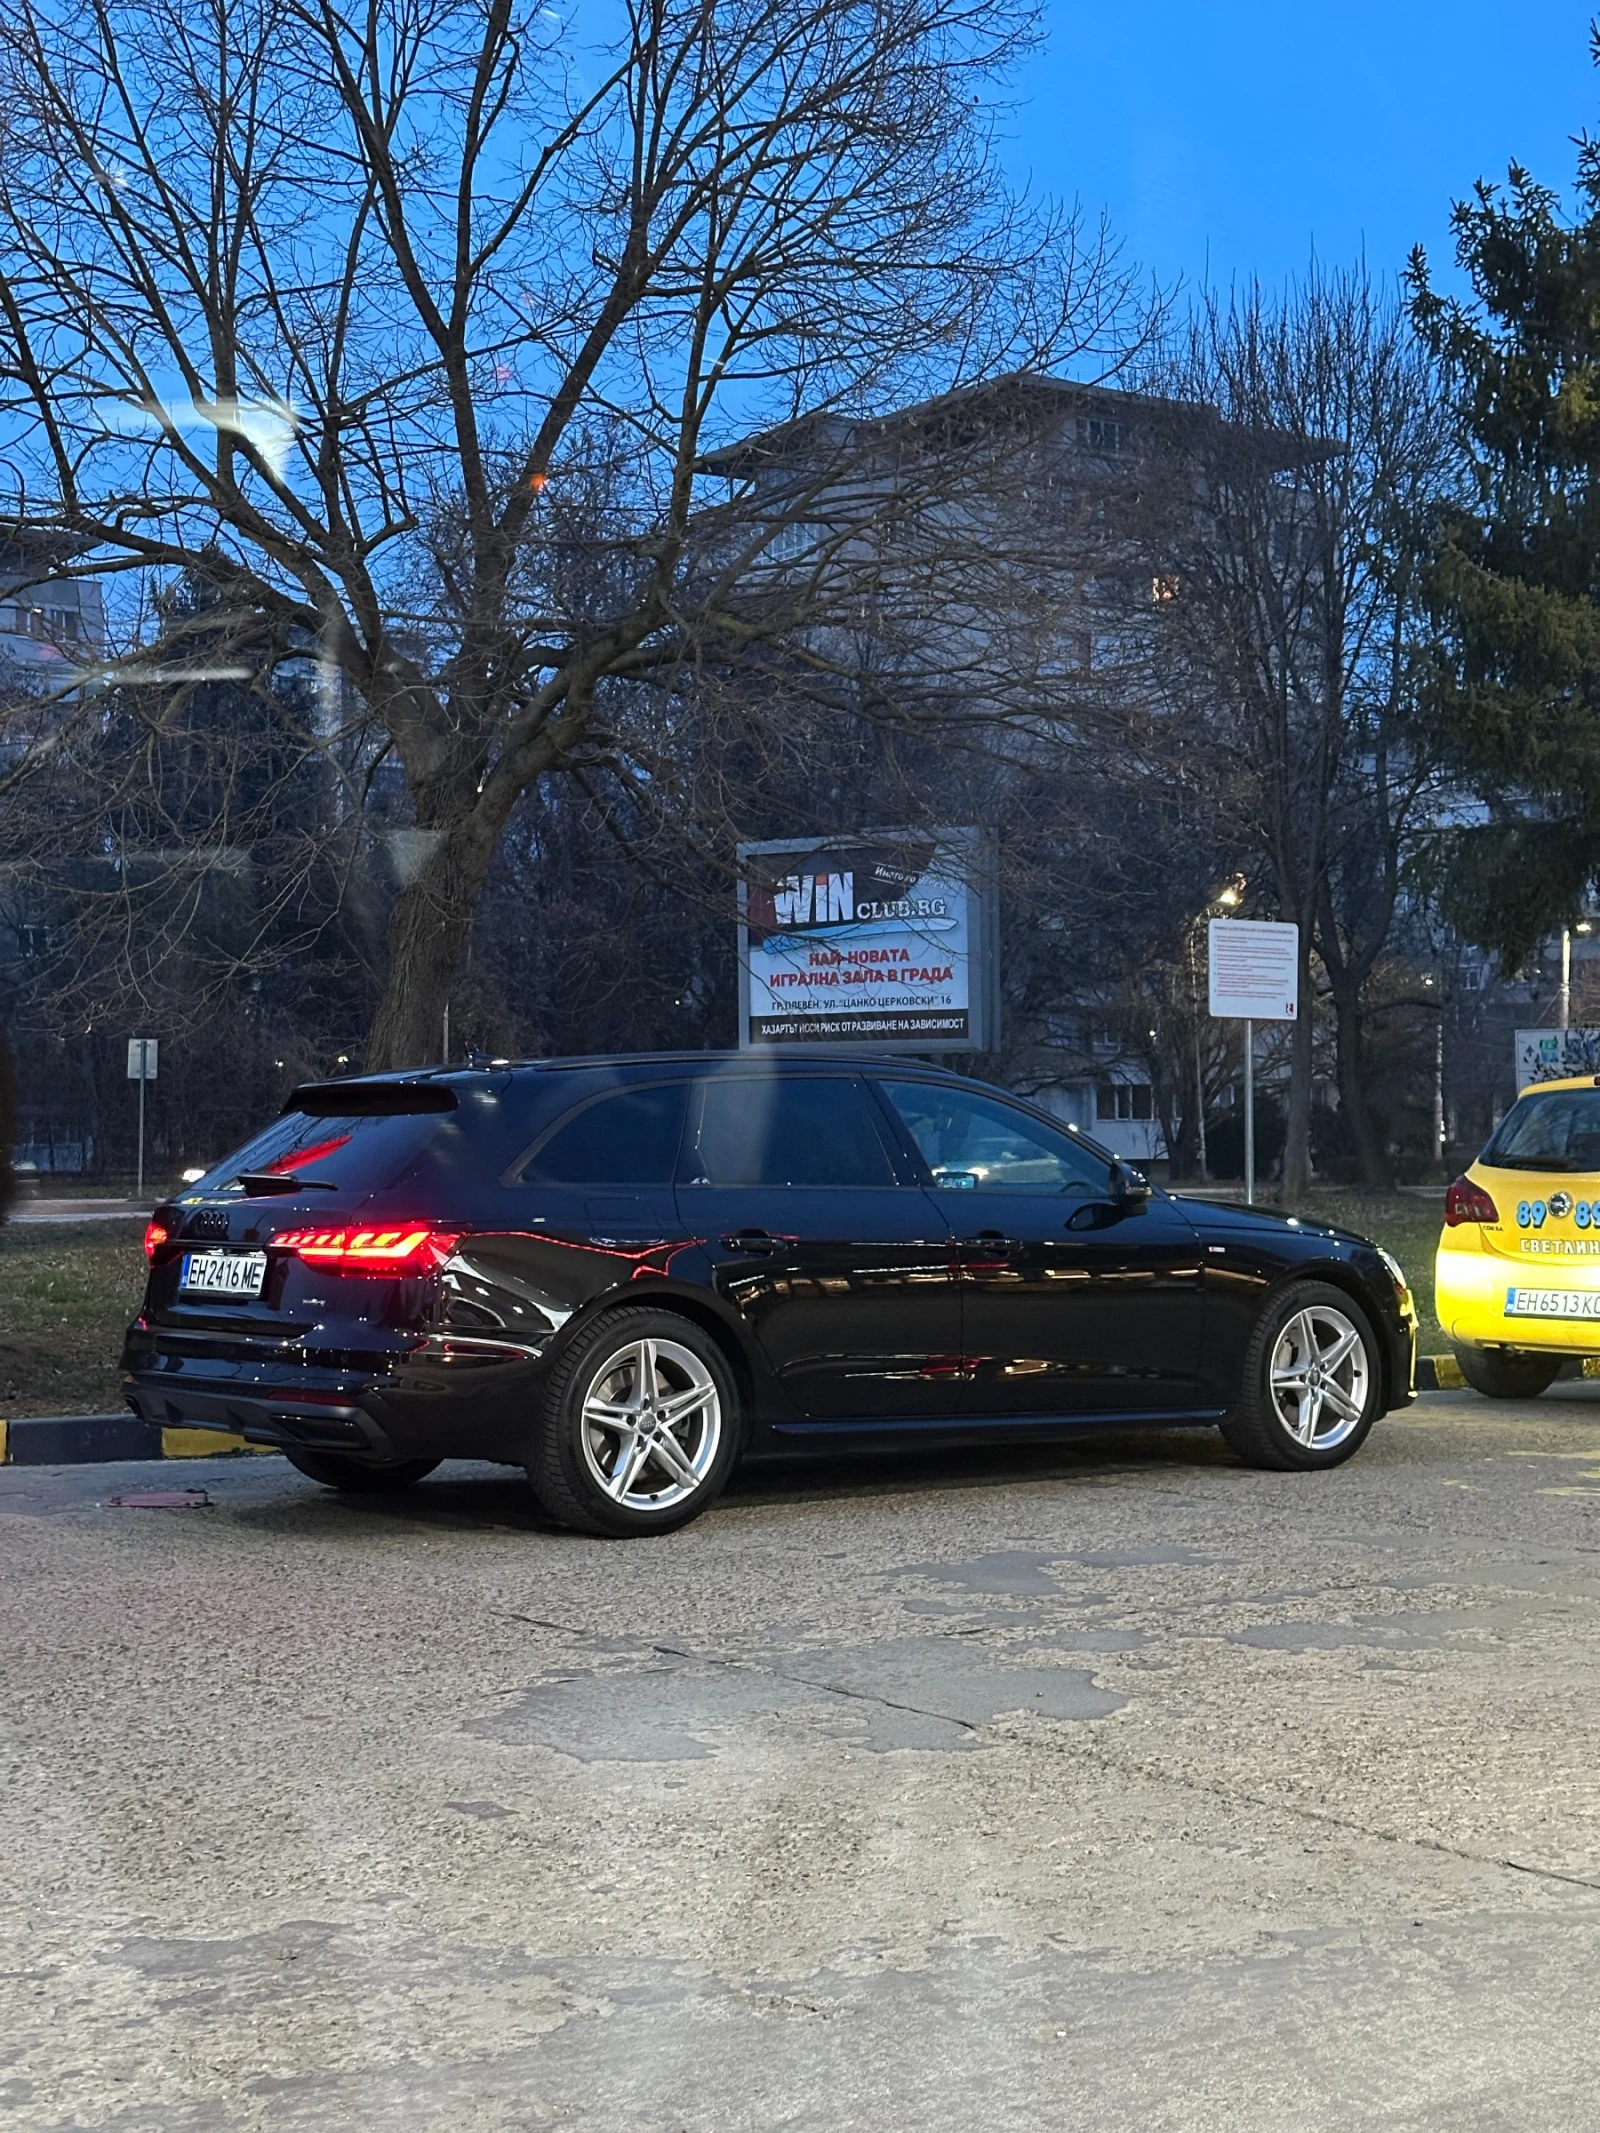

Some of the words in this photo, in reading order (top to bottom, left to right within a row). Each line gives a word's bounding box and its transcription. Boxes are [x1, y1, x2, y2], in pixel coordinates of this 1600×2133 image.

[769, 971, 840, 988] ИГРАЛНА
[842, 969, 885, 985] ЗАЛА
[887, 968, 898, 982] В
[900, 966, 954, 984] ГРАДА
[941, 995, 952, 1005] 16
[761, 1023, 798, 1035] ХАЗАРТЪТ
[799, 1021, 820, 1034] НОСИ
[820, 1021, 840, 1033] РИСК
[841, 1020, 851, 1032] ОТ
[851, 1019, 898, 1032] РАЗВИВАНЕ
[897, 1019, 909, 1031] НА
[910, 1017, 965, 1031] ЗАВИСИМОСТ
[1516, 1200, 1547, 1229] 89
